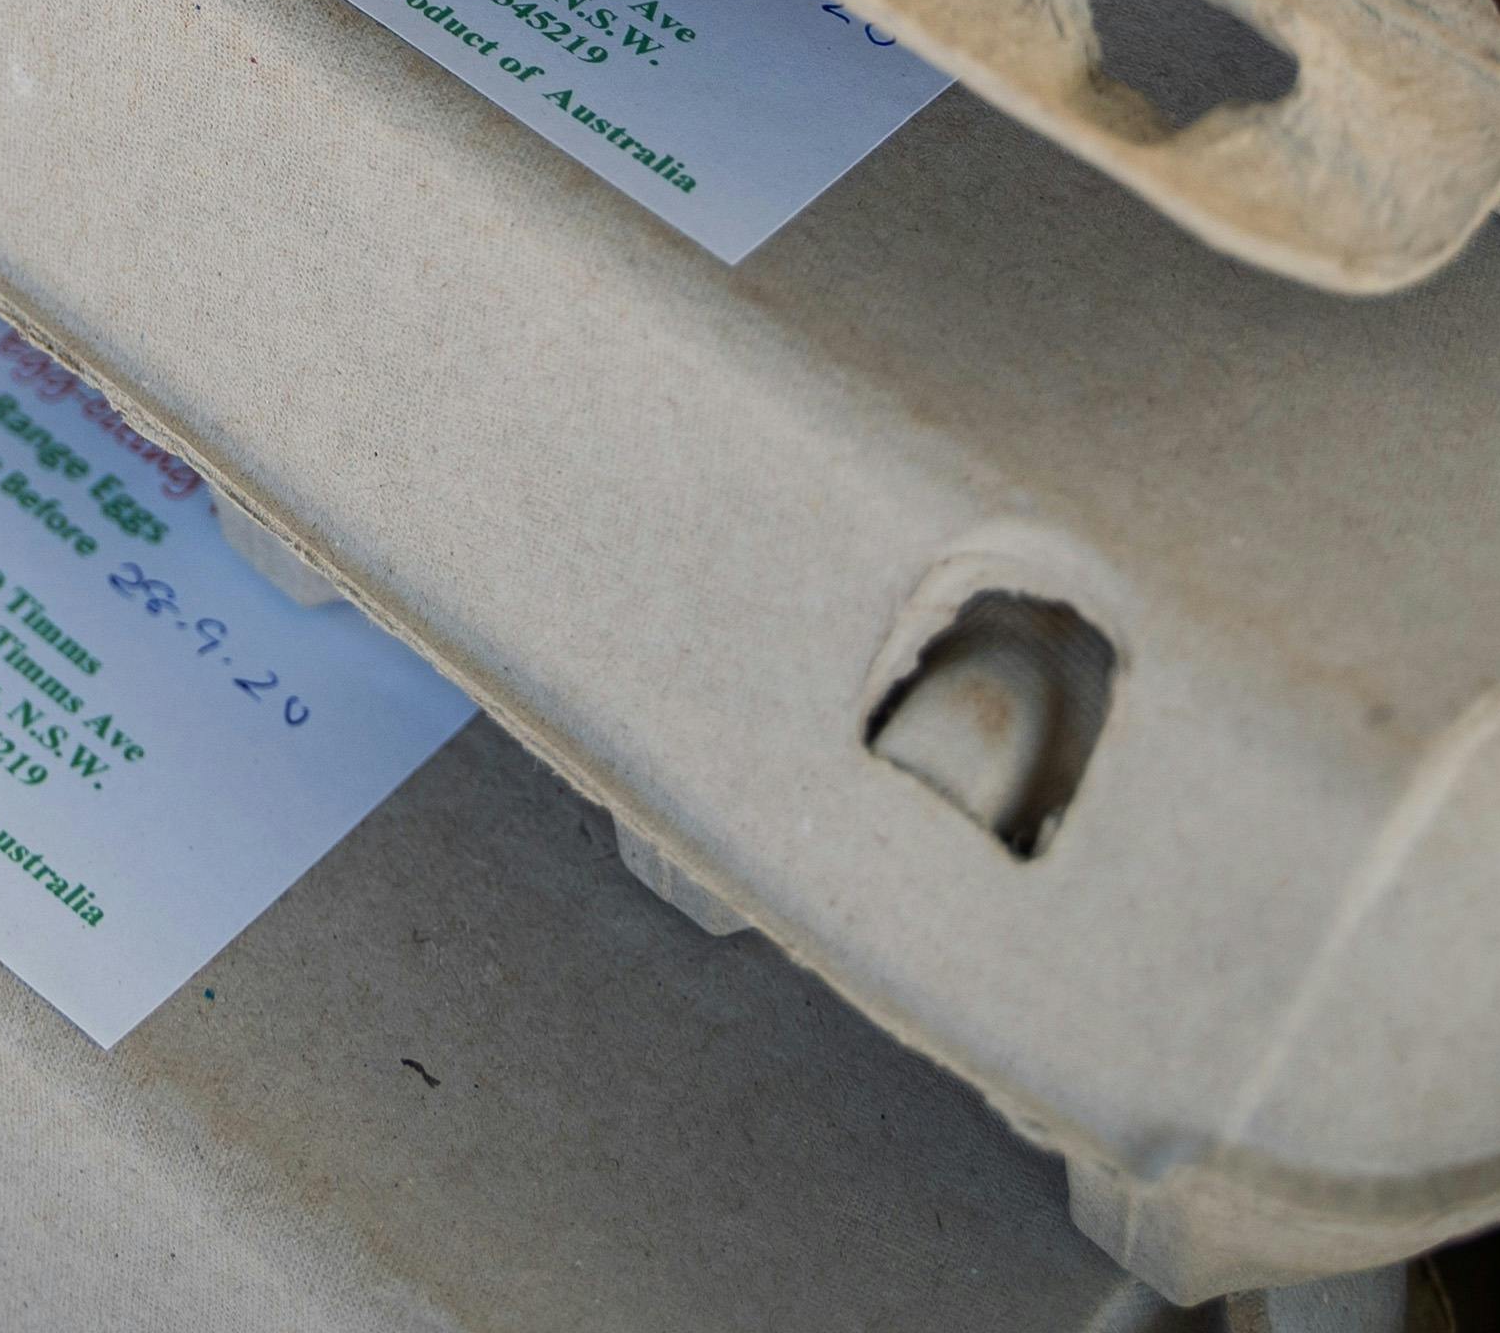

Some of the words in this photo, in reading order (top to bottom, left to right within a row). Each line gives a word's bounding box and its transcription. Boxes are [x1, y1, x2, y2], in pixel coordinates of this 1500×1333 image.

[628, 0, 697, 43] Ave
[498, 56, 546, 83] of
[543, 89, 697, 194] Australia
[0, 470, 98, 557] Before
[88, 472, 170, 545] Eggs
[6, 586, 102, 676] Timms
[7, 699, 110, 791] N.S.W.
[83, 714, 145, 762] Ave
